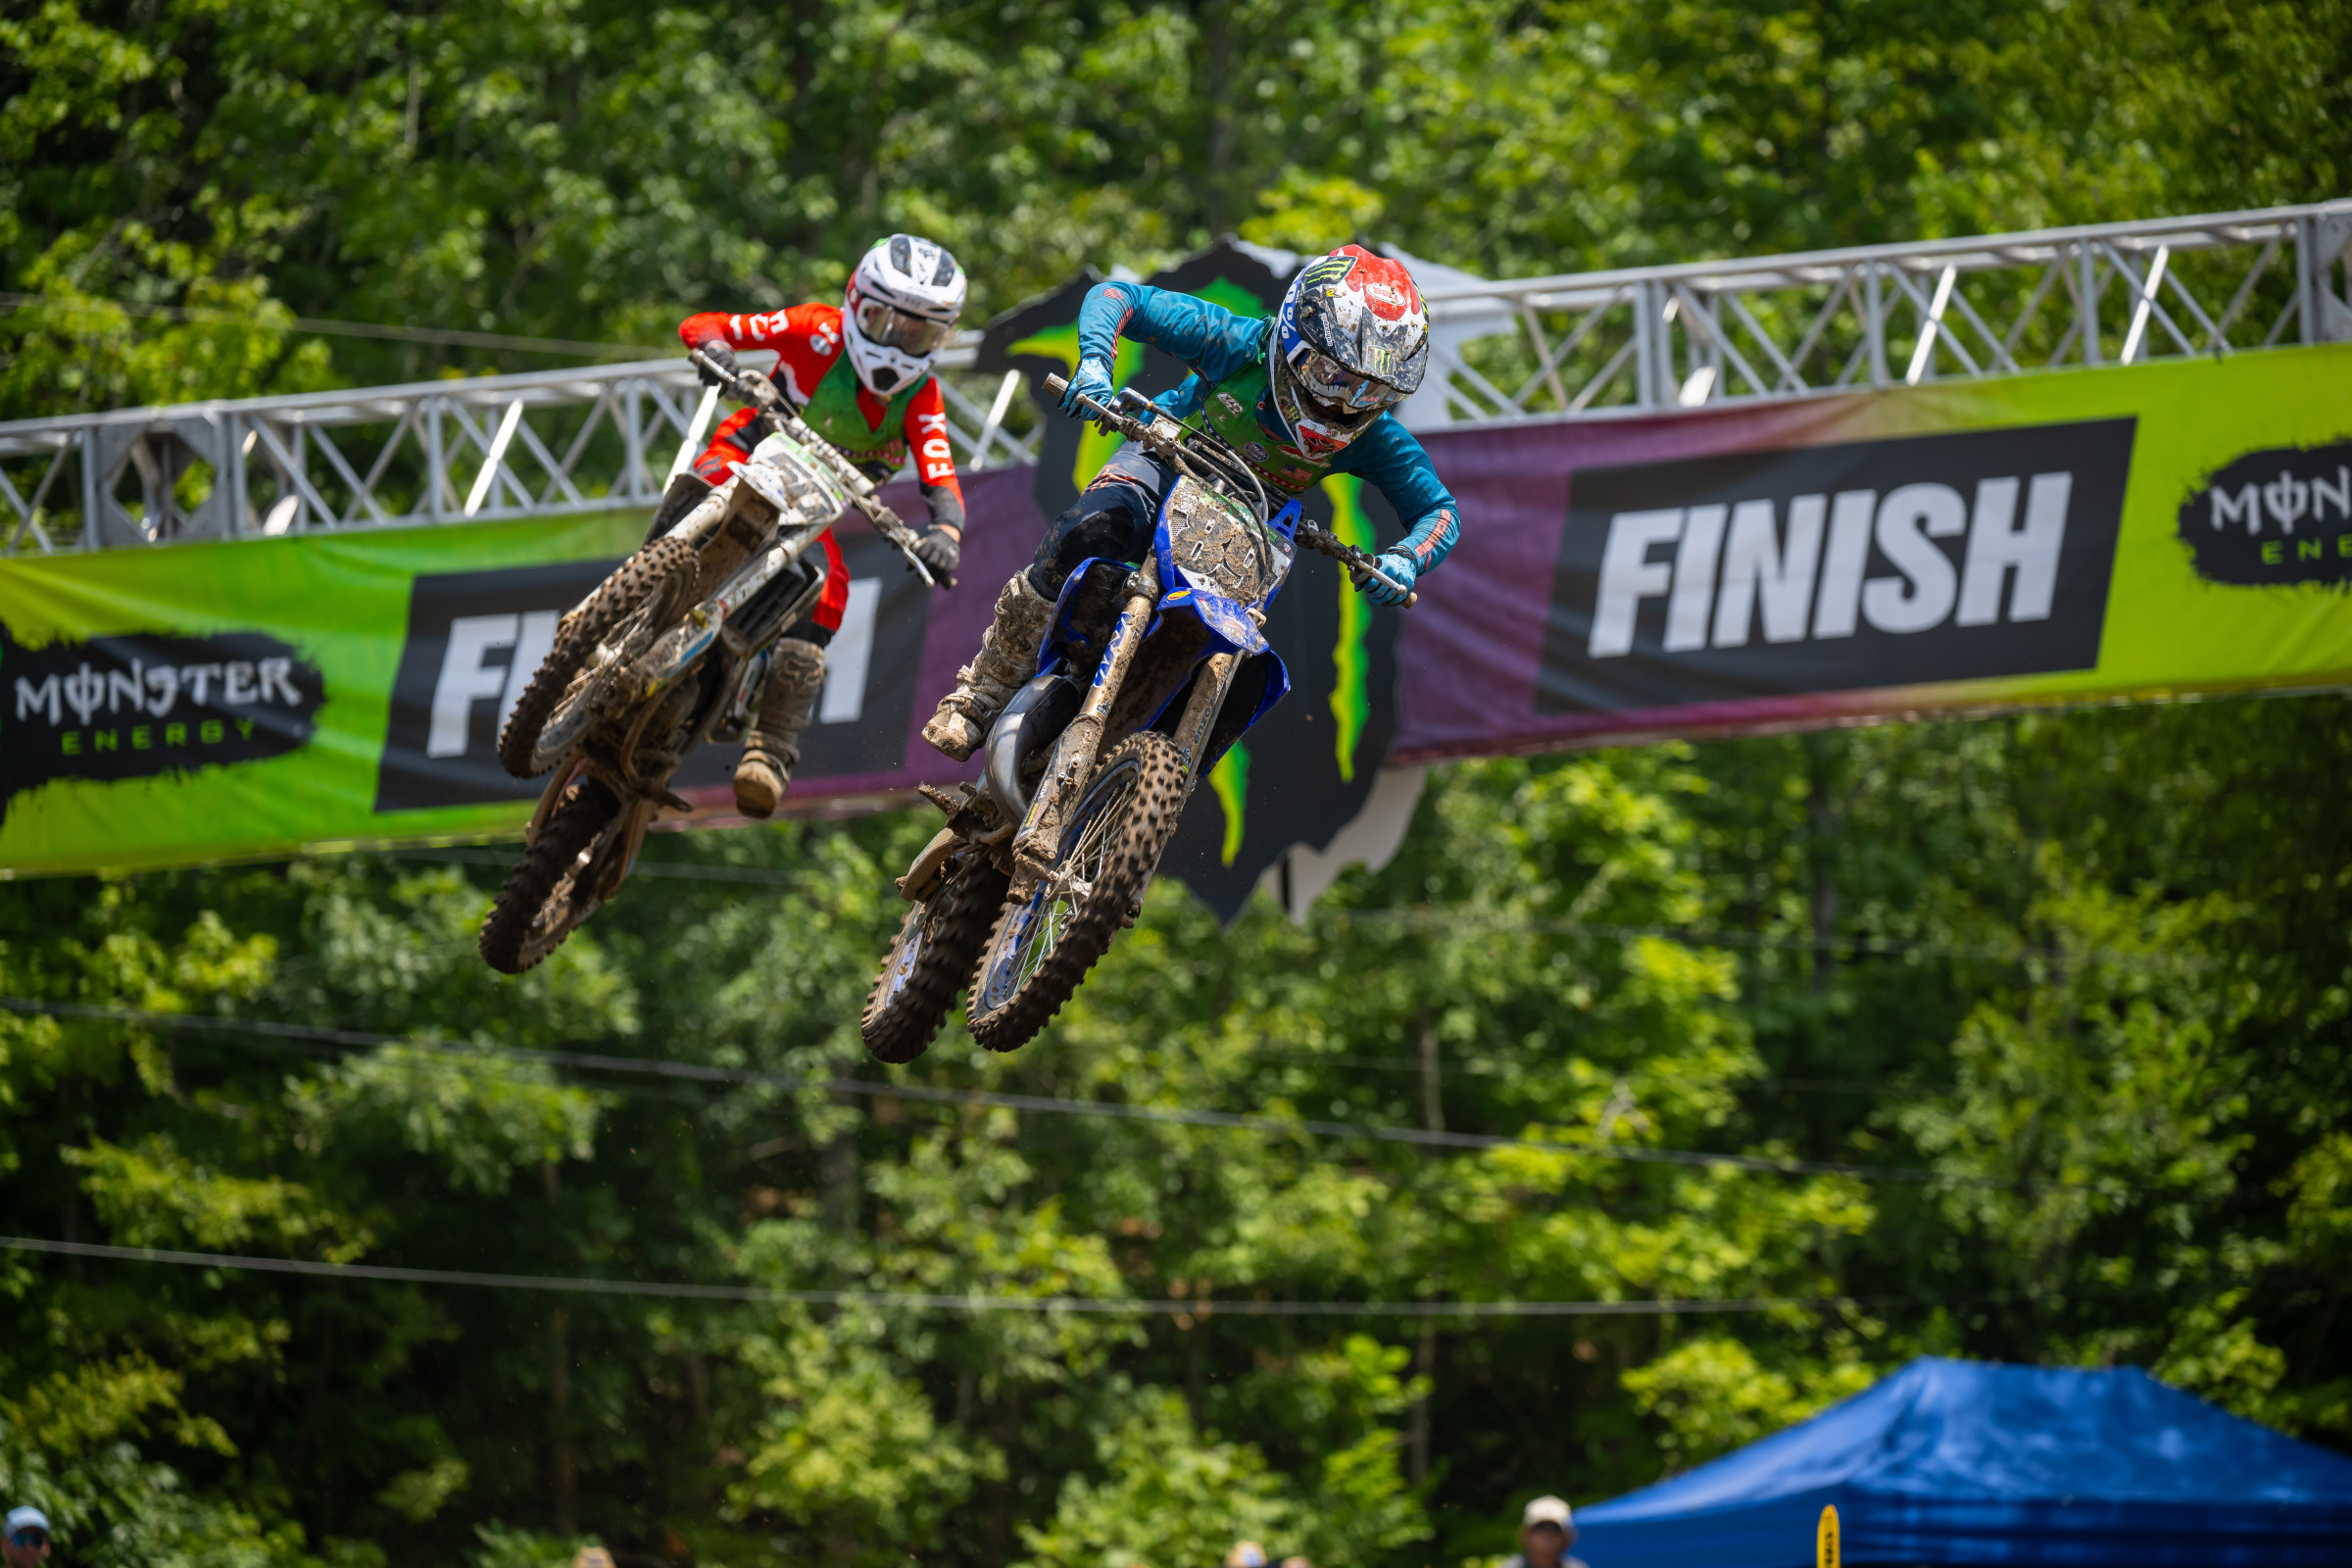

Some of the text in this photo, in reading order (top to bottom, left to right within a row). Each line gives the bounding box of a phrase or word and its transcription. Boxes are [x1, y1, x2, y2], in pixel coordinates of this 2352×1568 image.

[1373, 287, 1399, 303] BELL
[918, 412, 956, 479] FOX
[1588, 471, 2073, 659] FINISH
[15, 656, 303, 726] MONSTER
[61, 717, 254, 756] ENERGY
